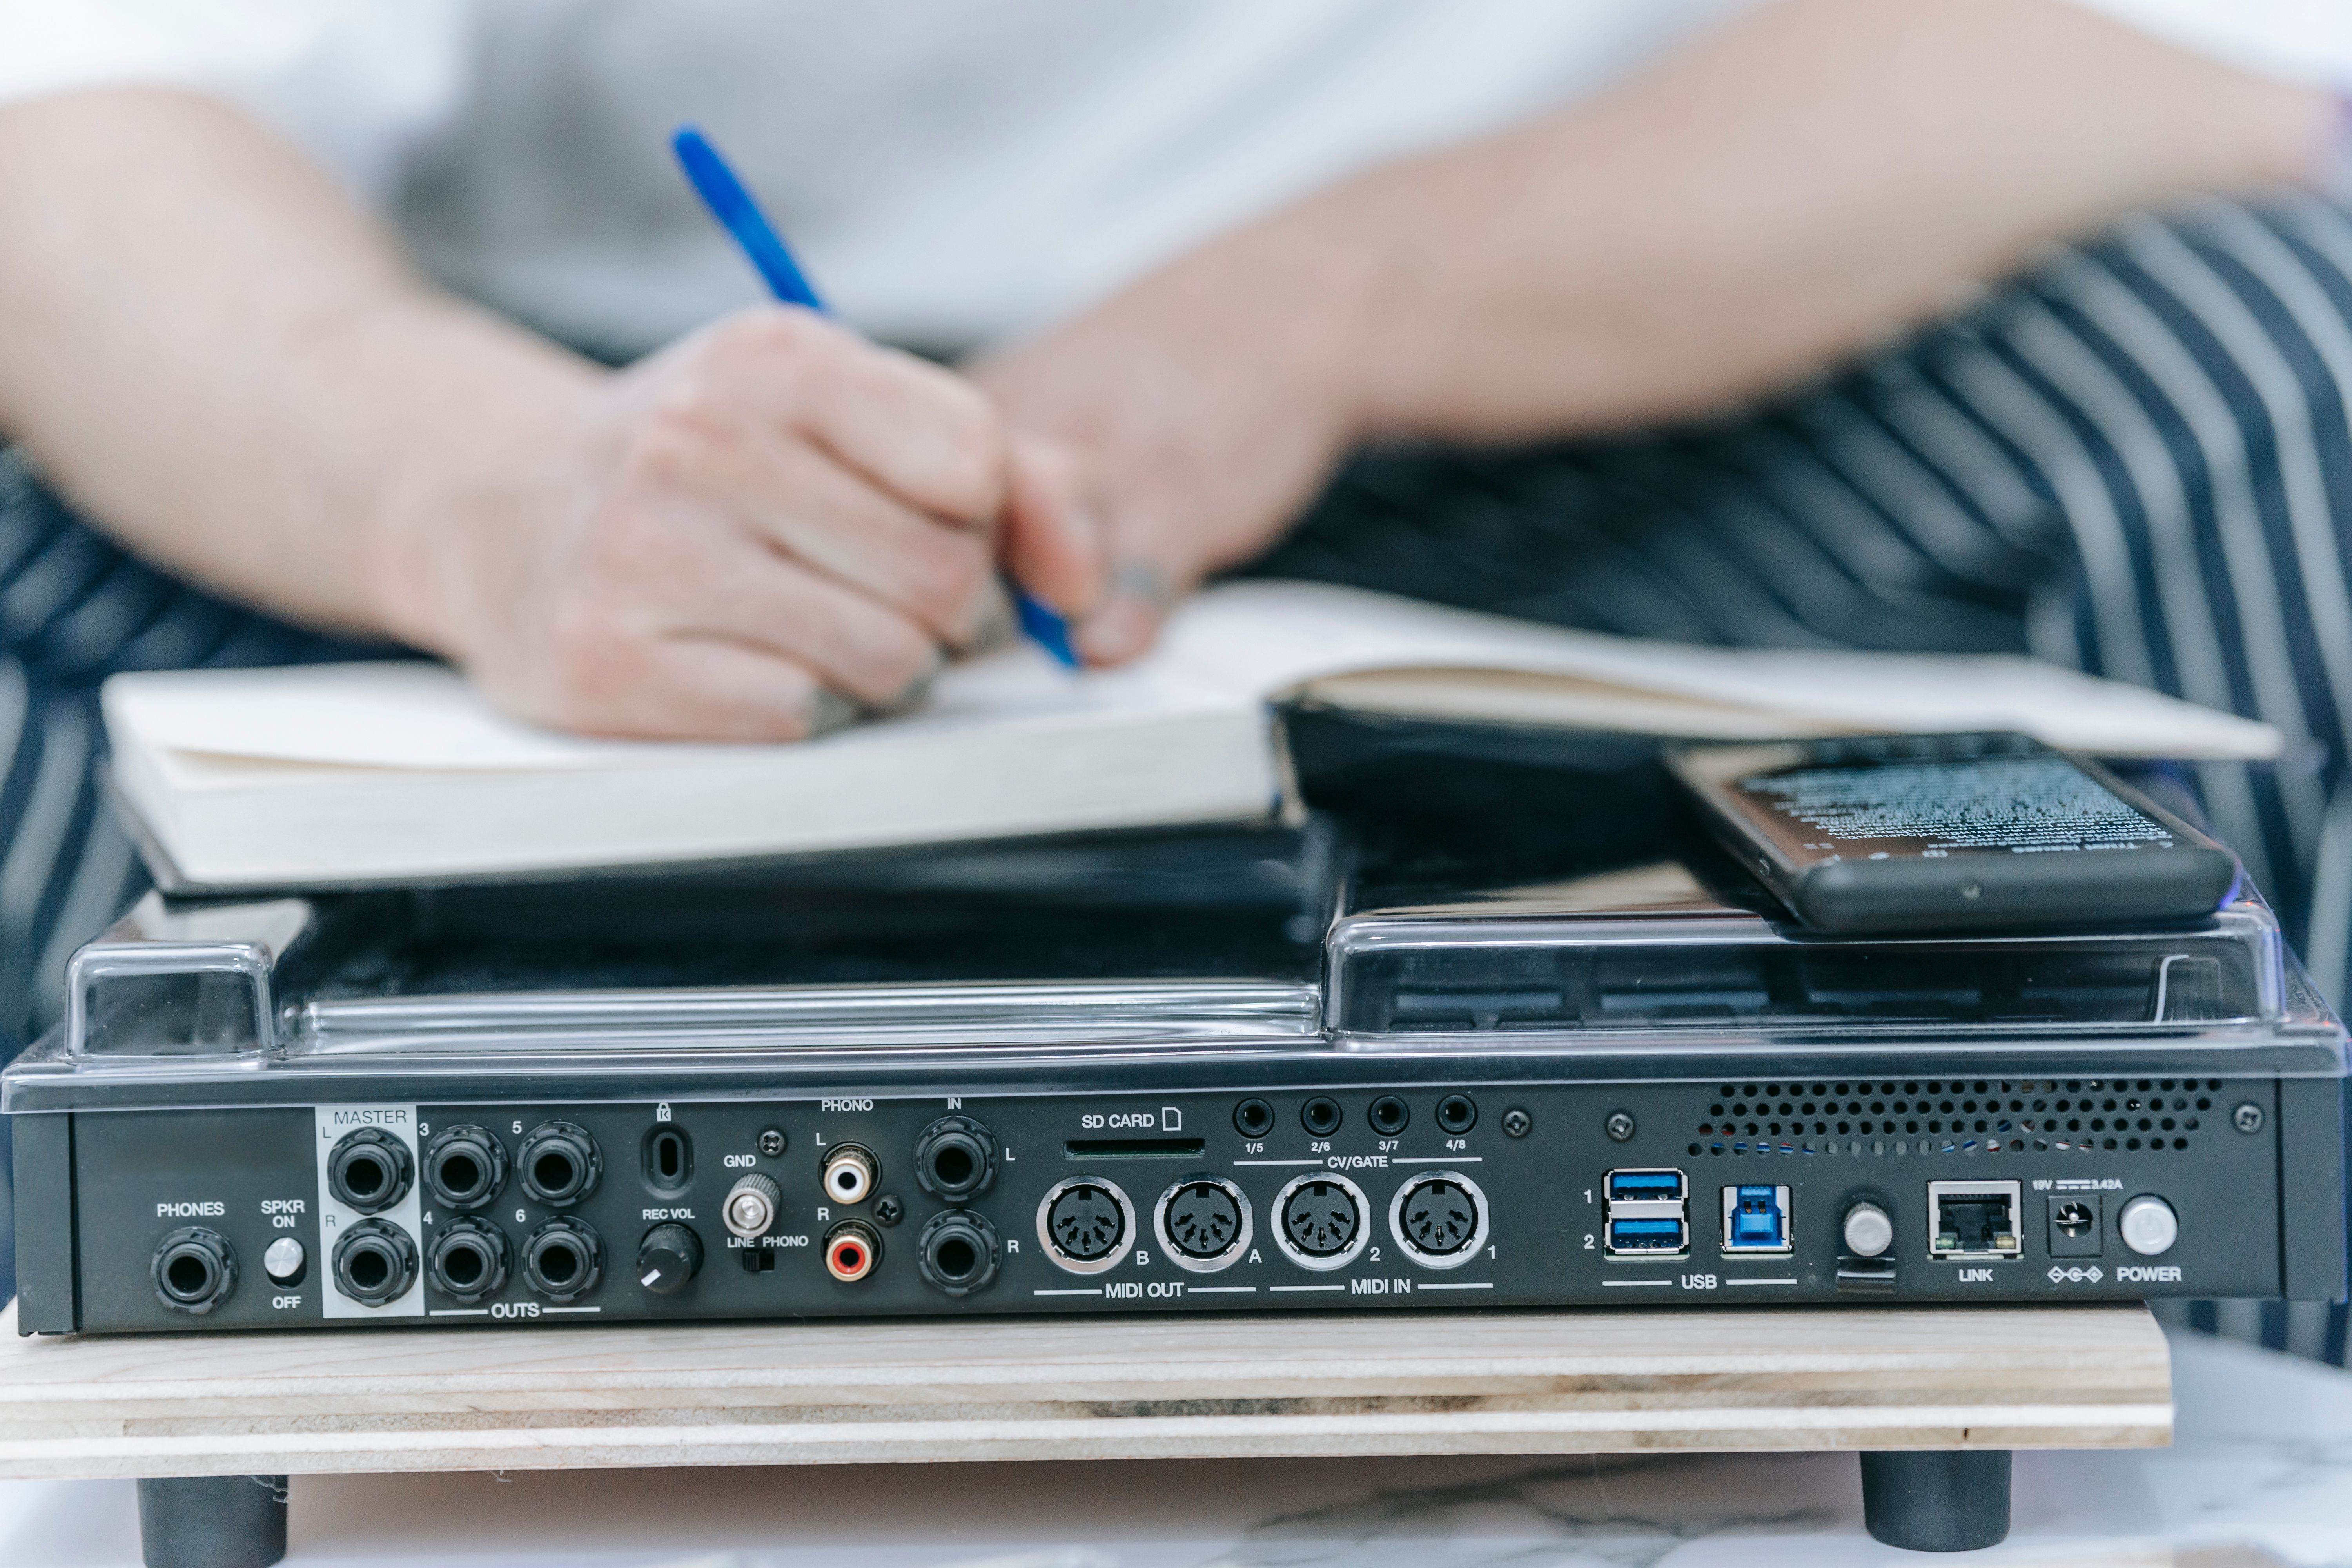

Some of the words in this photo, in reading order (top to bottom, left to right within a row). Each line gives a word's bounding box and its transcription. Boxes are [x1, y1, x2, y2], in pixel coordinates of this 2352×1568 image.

[821, 1099, 873, 1112] PHONO
[947, 1098, 962, 1109] IN
[334, 1110, 407, 1124] MASTER
[1082, 1114, 1105, 1129] SD
[1108, 1114, 1155, 1128] CARD
[323, 1127, 332, 1138] L
[419, 1123, 429, 1136] 3
[512, 1120, 522, 1134] 5
[816, 1132, 826, 1146] L
[1379, 1140, 1399, 1152] 3/7
[1446, 1139, 1466, 1151] 4/8
[1005, 1147, 1016, 1161] L
[1245, 1143, 1263, 1154] 1/5
[1311, 1142, 1330, 1154] 2/6
[724, 1154, 756, 1167] GND
[1327, 1156, 1388, 1171] CV/GATE
[2032, 1180, 2053, 1190] 19V
[2090, 1178, 2123, 1190] 3.42A
[1584, 1189, 1592, 1204] 1
[157, 1201, 225, 1217] PHONES
[261, 1200, 305, 1214] SPKR
[642, 1209, 668, 1220] REC
[670, 1208, 695, 1219] VOL
[817, 1207, 829, 1221] R
[272, 1215, 295, 1228] ON
[325, 1215, 336, 1227] R
[423, 1211, 433, 1225] 4
[515, 1209, 526, 1223] 6
[727, 1236, 756, 1248] LINE
[762, 1235, 809, 1247] PHONO
[1007, 1240, 1019, 1253] R
[1584, 1234, 1595, 1249] 2
[1136, 1250, 1149, 1265] B
[1249, 1249, 1262, 1263] A
[1370, 1247, 1381, 1261] 2
[1488, 1245, 1495, 1259] 1
[1958, 1269, 1994, 1282] LINK
[2117, 1266, 2182, 1282] POWER
[1351, 1279, 1389, 1294] MIDI
[1393, 1278, 1411, 1294] IN
[1681, 1274, 1718, 1289] USB
[1105, 1283, 1143, 1298] MIDI
[1147, 1282, 1185, 1298] OUT
[272, 1296, 301, 1309] OFF
[491, 1302, 540, 1318] OUTS
